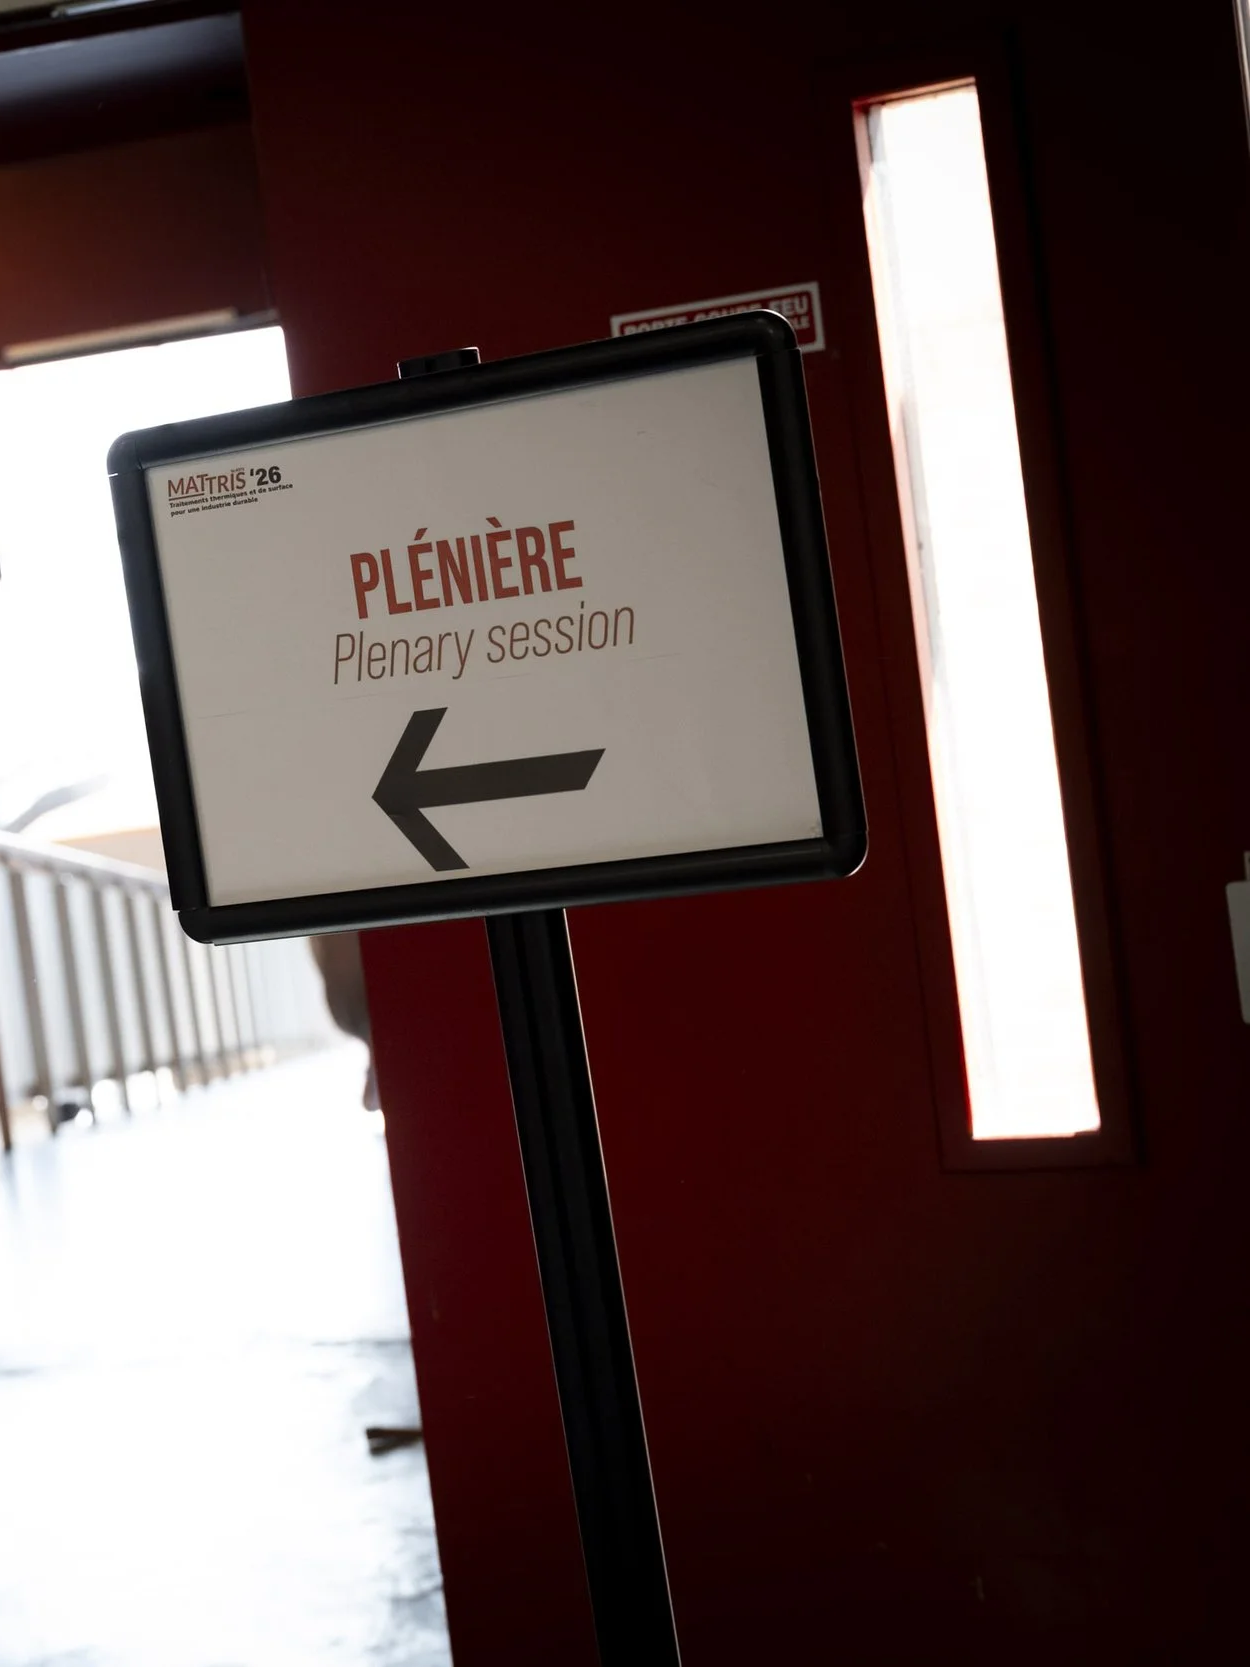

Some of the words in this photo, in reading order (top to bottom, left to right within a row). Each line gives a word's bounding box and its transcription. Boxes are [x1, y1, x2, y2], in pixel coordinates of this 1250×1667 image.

[167, 471, 246, 498] MATTRIS
[169, 497, 209, 509] Traitements
[210, 491, 248, 502] thermiques
[249, 488, 257, 496] et
[258, 486, 267, 494] de
[268, 482, 294, 492] surface
[170, 508, 186, 518] pour
[187, 506, 200, 514] une
[201, 500, 232, 511] industrie
[232, 496, 258, 506] durable
[350, 516, 583, 619] PLÉNIÈRE
[334, 629, 475, 684] Plenary
[486, 601, 635, 664] session
